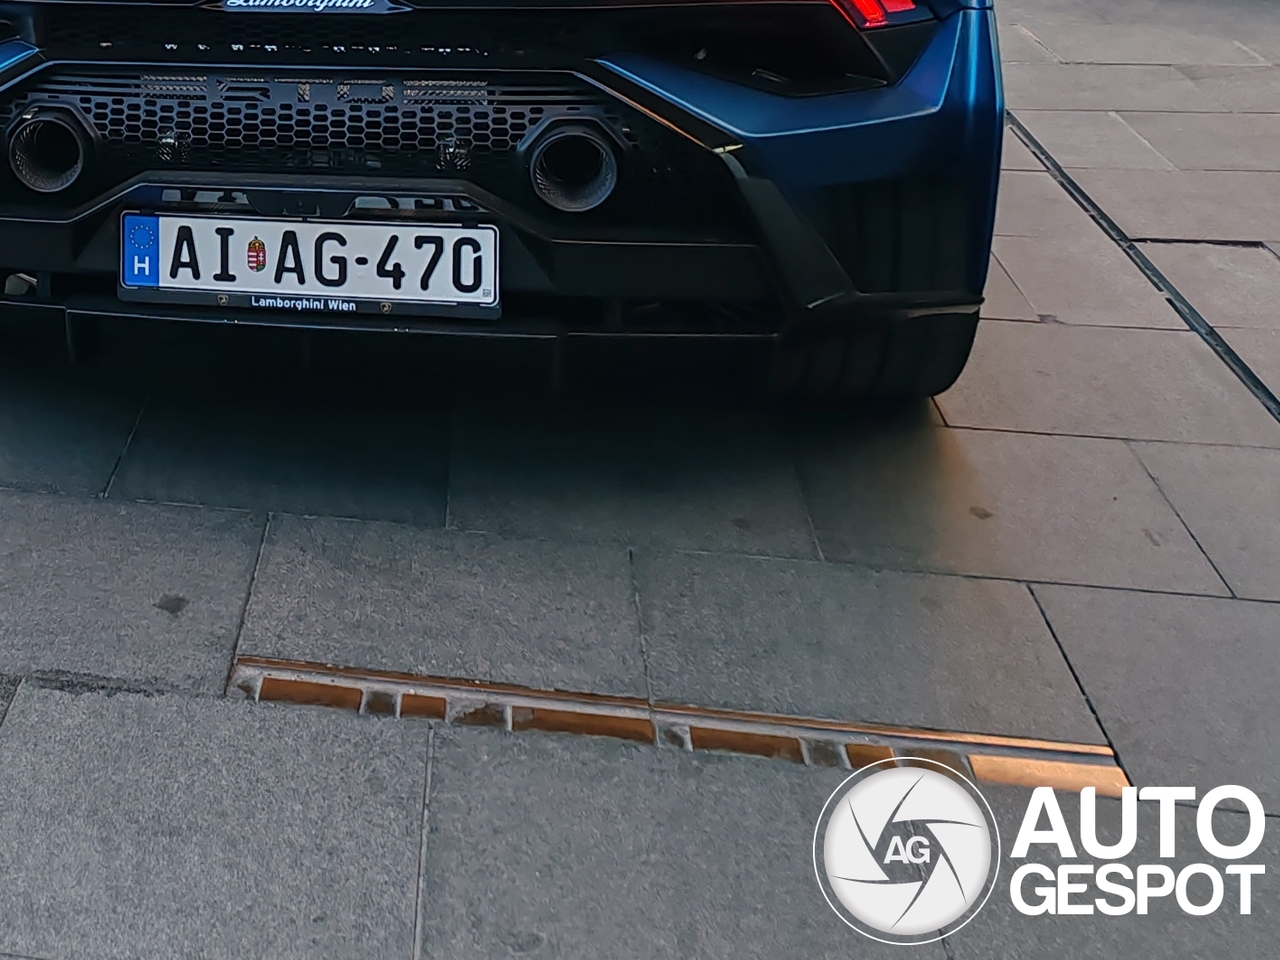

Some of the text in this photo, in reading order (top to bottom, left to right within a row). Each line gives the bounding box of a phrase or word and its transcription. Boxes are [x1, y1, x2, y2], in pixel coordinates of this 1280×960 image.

[133, 255, 150, 277] H
[168, 225, 483, 294] AI AG-470
[251, 296, 357, 313] Lamborghini Wien
